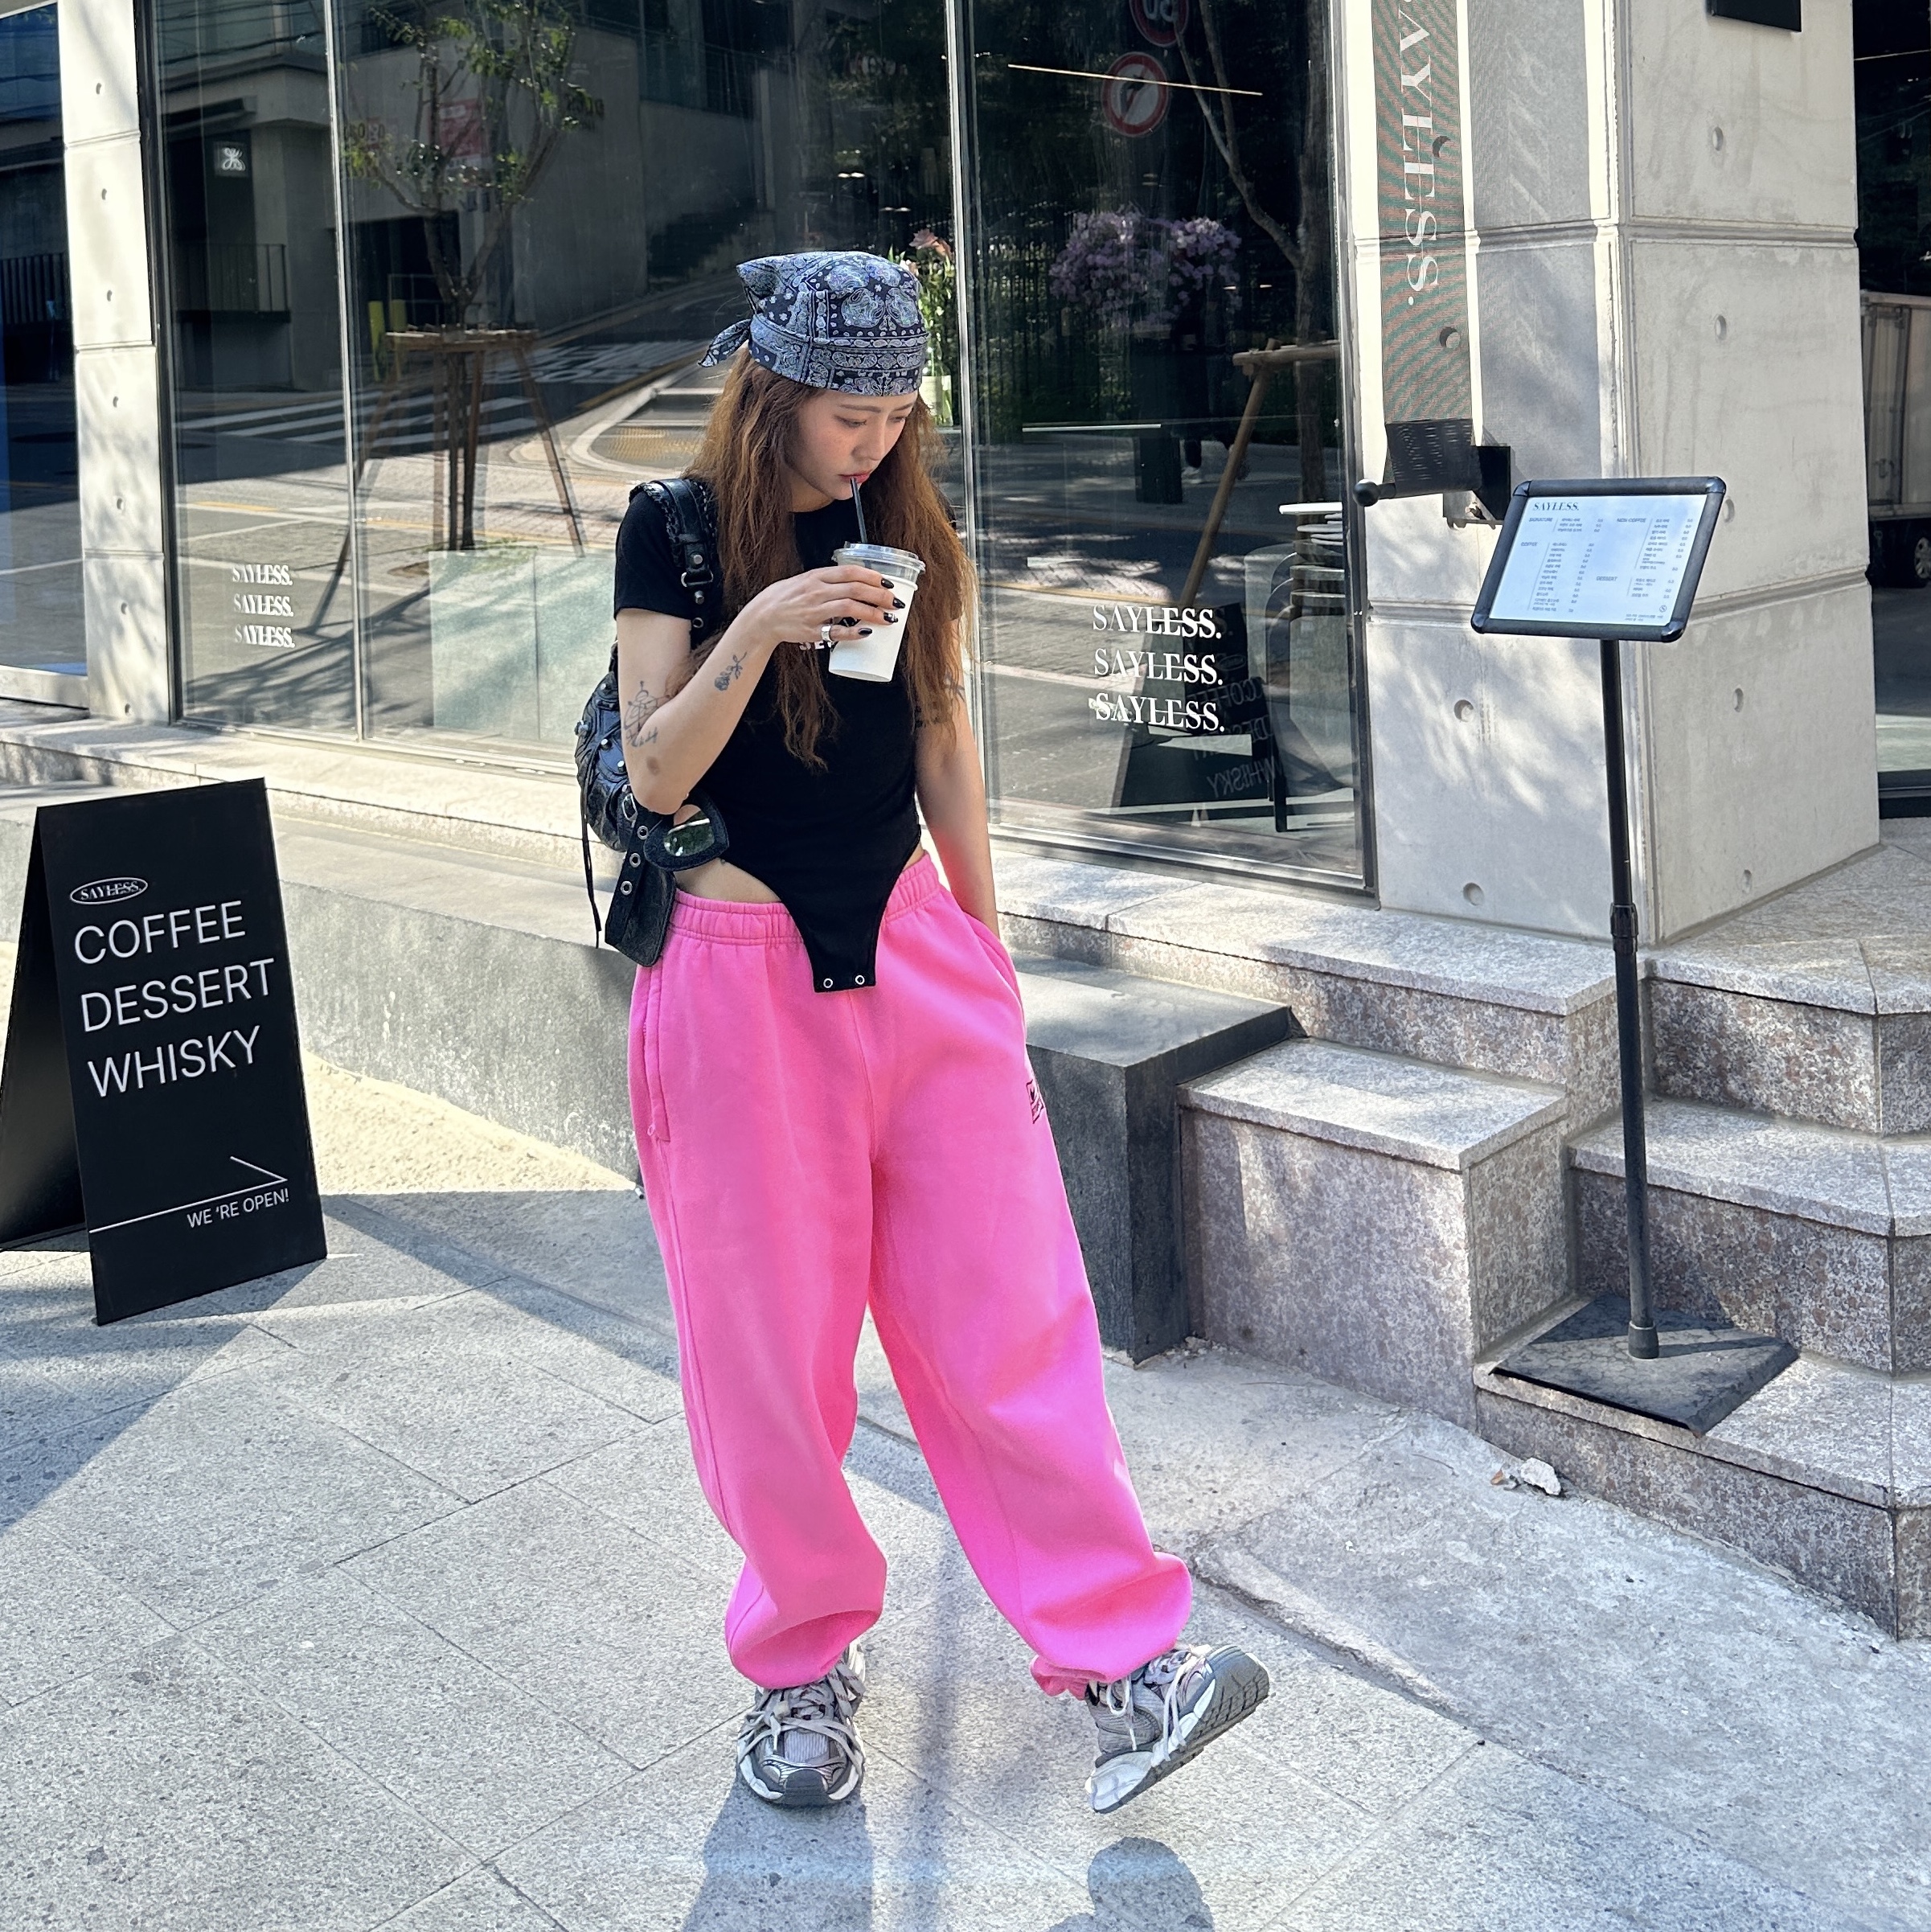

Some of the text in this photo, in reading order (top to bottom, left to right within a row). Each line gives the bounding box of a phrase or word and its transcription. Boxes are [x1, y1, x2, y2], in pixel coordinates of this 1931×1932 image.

[1399, 0, 1438, 305] AYLESS.
[1093, 605, 1222, 639] SAYLESS.
[1094, 648, 1224, 686] SAYLESS.
[1096, 692, 1224, 732] SAYLESS.
[75, 900, 246, 965] COFFEE
[81, 958, 274, 1032] DESSERT
[88, 1025, 260, 1097] WHISKY
[243, 1188, 289, 1212] OPEN!
